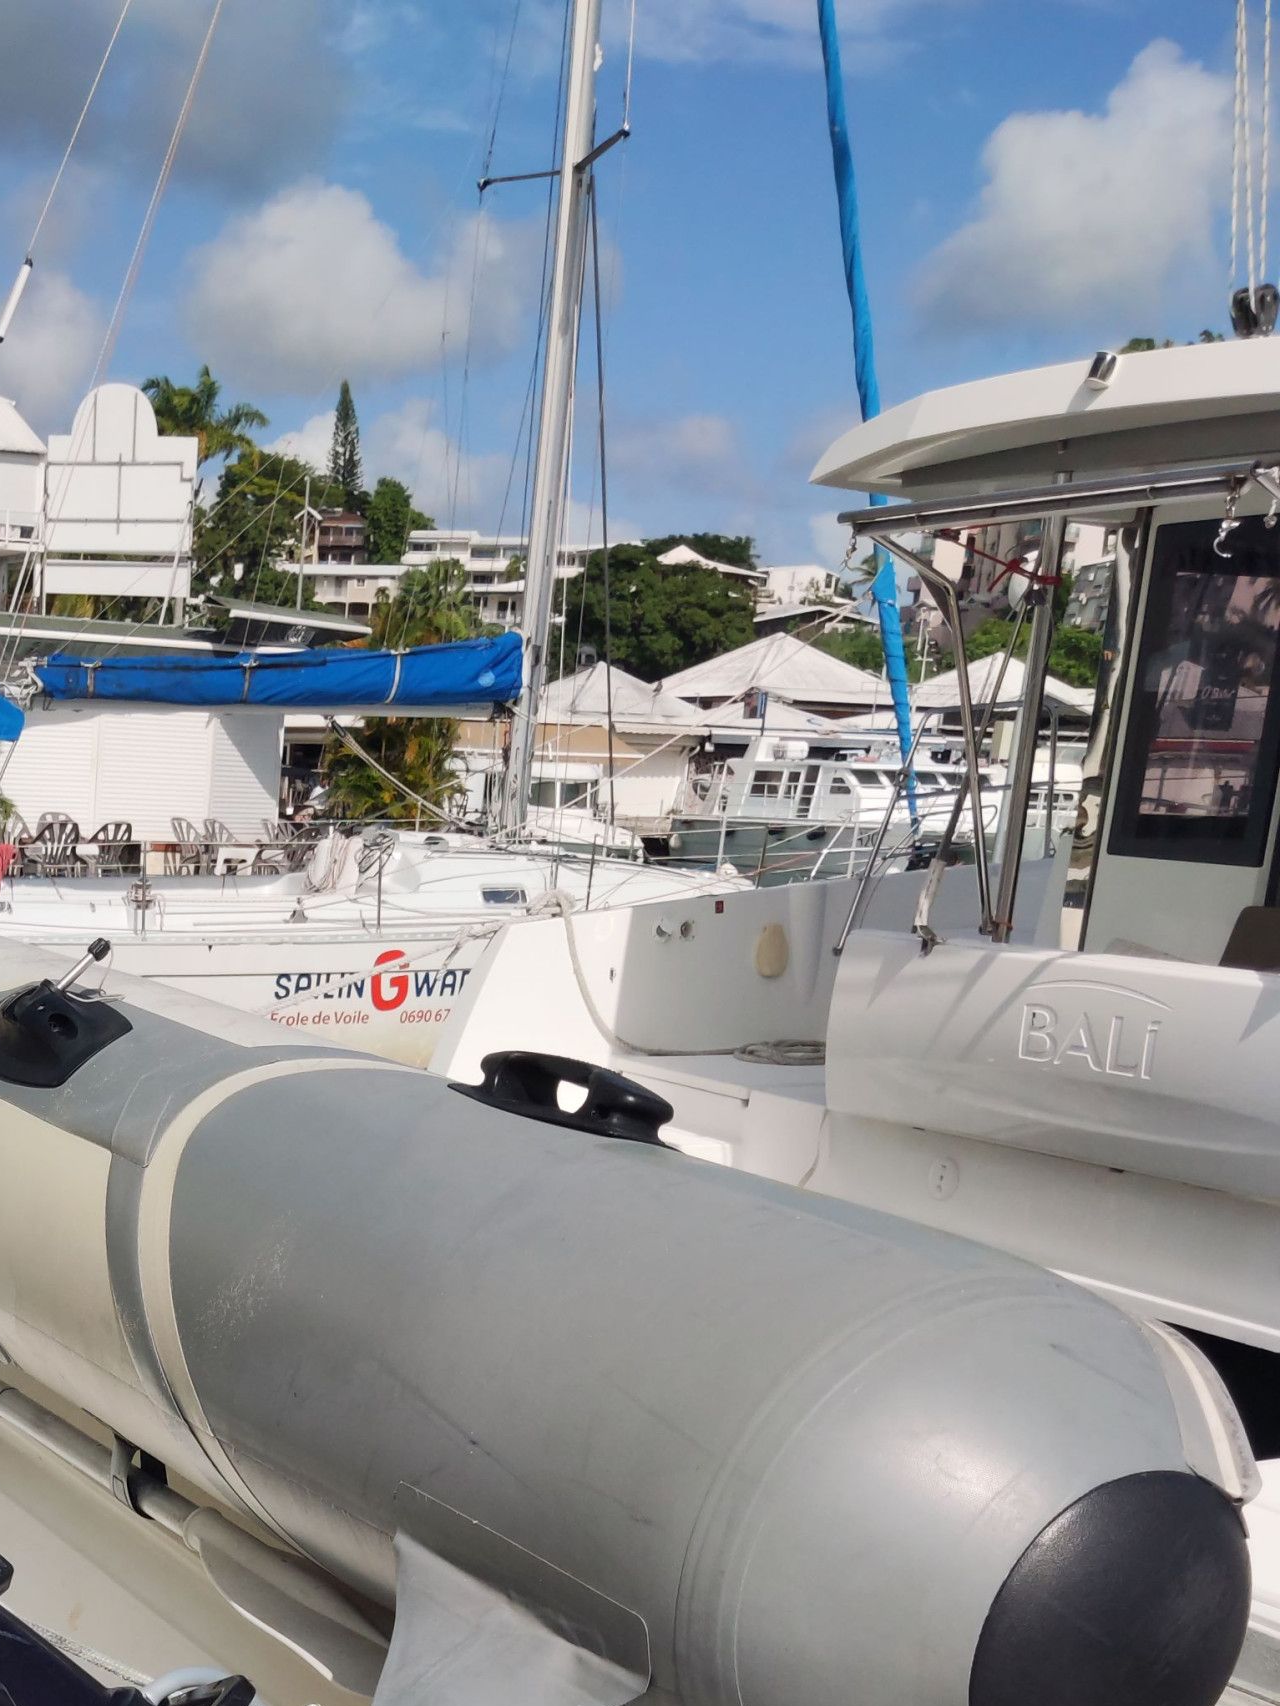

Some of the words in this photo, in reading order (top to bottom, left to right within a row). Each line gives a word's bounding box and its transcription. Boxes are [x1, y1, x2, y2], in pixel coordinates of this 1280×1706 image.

[312, 1011, 331, 1026] de
[334, 1010, 370, 1025] Voile
[399, 1009, 432, 1024] 0690
[434, 1008, 451, 1023] 67
